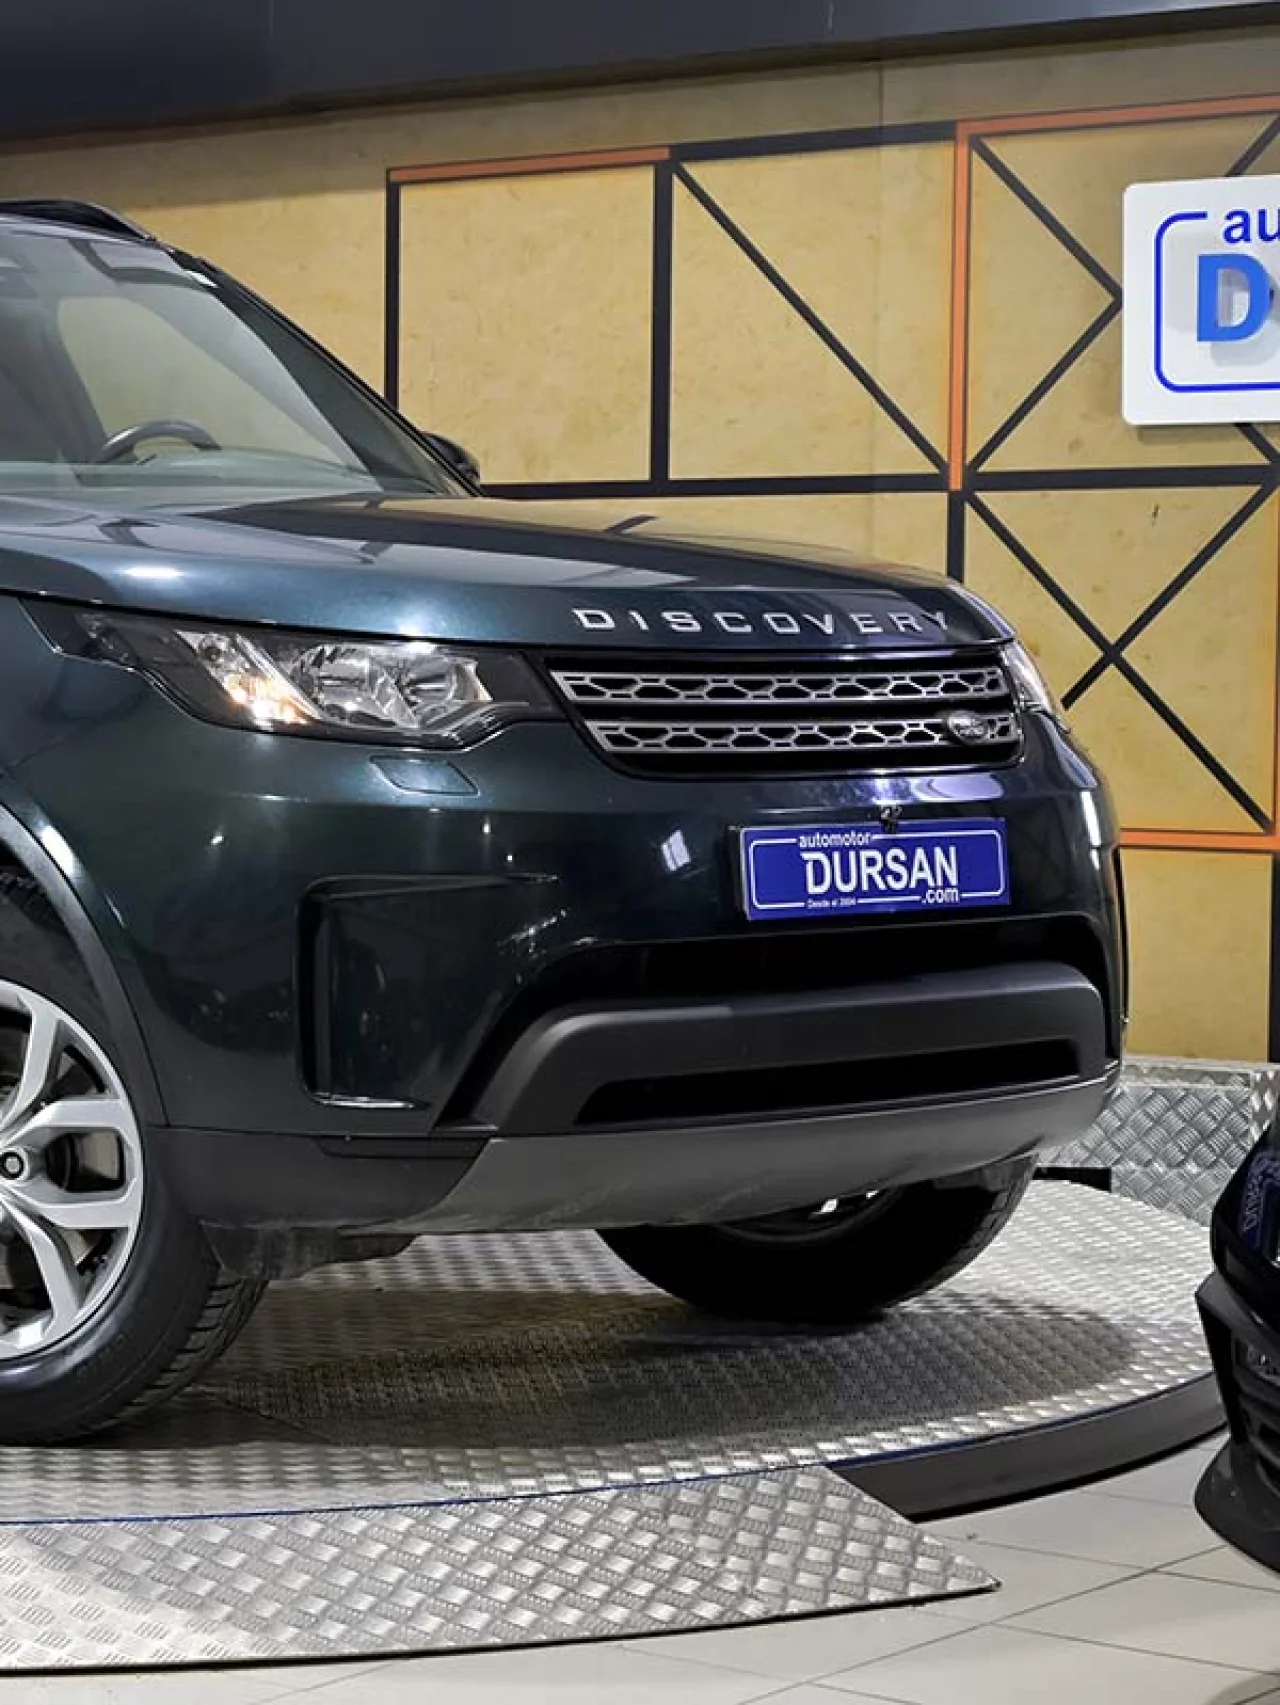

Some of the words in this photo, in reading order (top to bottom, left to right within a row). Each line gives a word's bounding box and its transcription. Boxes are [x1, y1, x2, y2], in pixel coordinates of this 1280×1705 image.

[571, 608, 949, 635] DISCOVERY
[798, 830, 871, 848] automotor
[800, 846, 959, 895] DURSAN
[922, 887, 959, 904] .com
